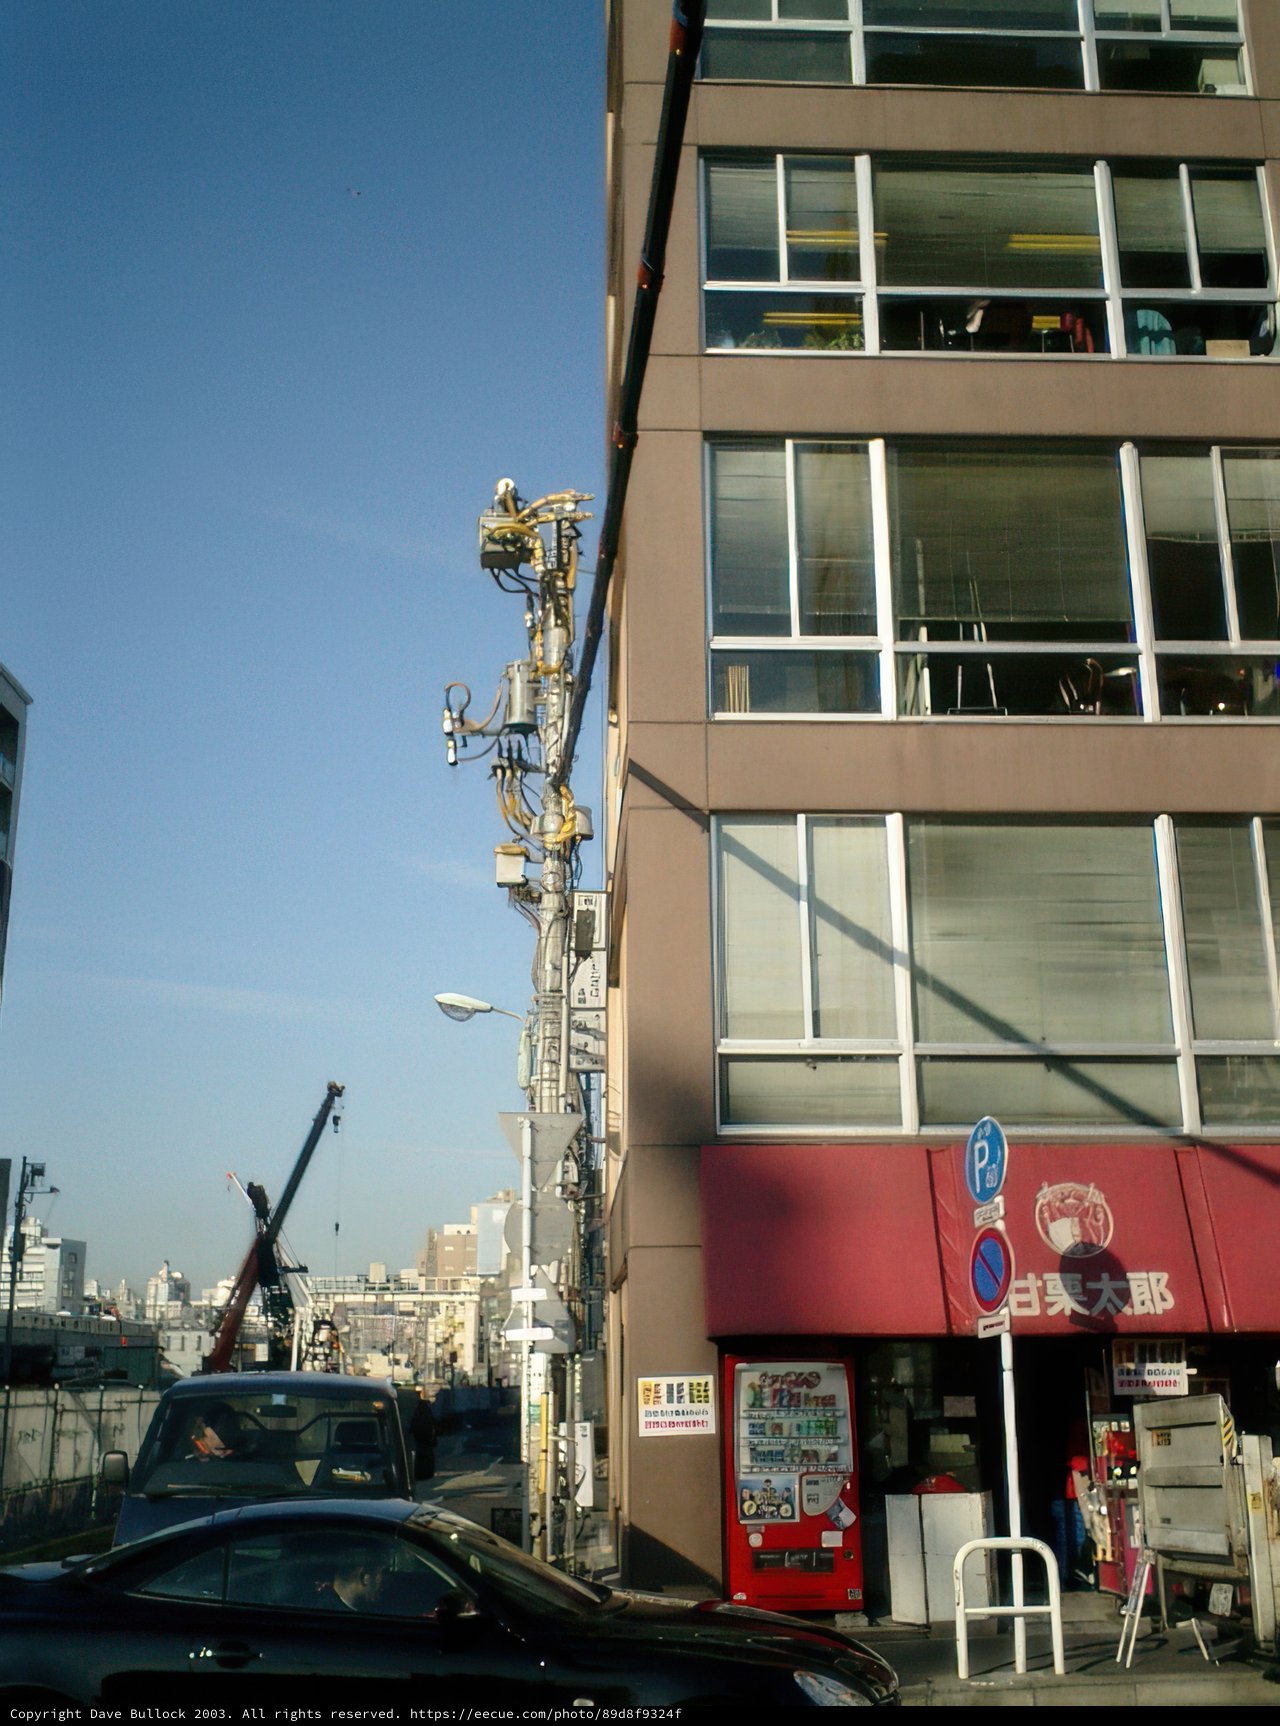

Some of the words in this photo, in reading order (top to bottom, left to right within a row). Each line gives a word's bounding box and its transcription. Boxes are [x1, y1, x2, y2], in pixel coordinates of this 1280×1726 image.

[974, 1141, 989, 1193] P
[1010, 1271, 1175, 1317] 甘栗太郎
